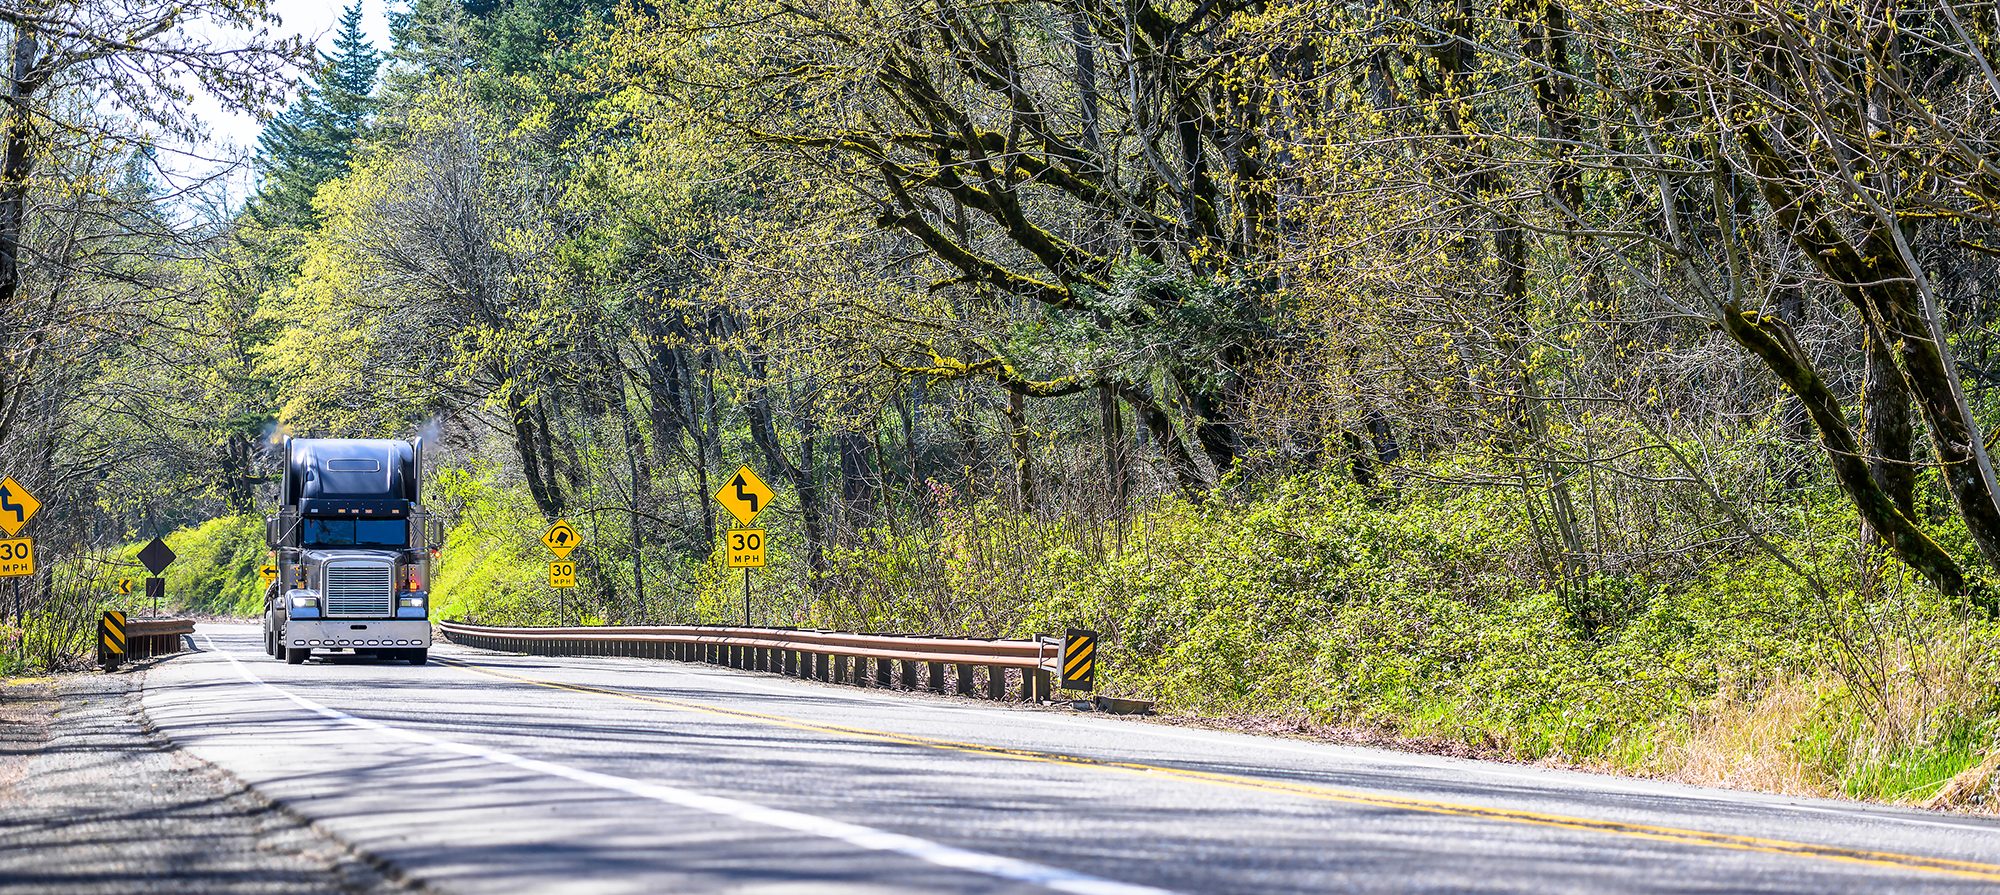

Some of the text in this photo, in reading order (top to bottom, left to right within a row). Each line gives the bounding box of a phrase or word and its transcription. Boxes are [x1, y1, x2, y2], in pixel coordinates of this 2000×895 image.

[733, 534, 760, 551] 30
[0, 543, 28, 560] 30
[3, 564, 28, 572] MPH
[553, 565, 571, 576] 30
